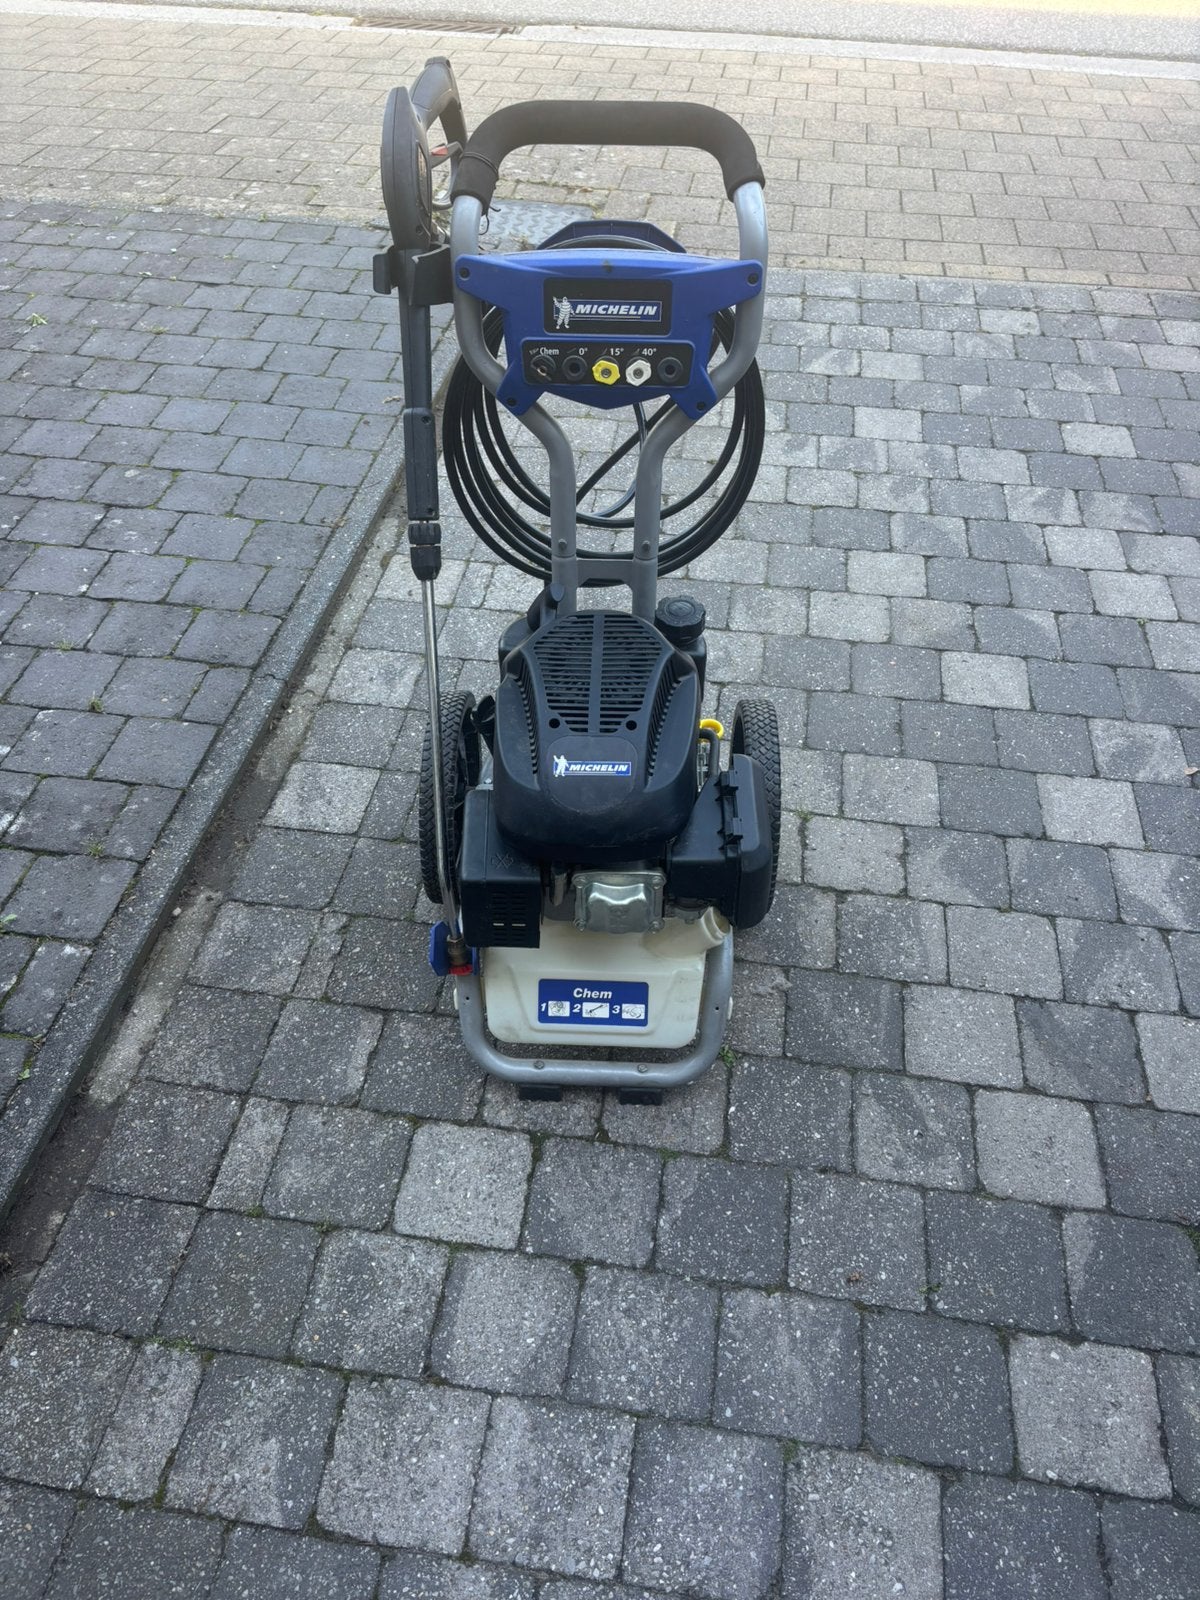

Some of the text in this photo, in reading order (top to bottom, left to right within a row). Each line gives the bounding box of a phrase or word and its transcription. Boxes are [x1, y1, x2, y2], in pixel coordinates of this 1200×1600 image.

[575, 304, 657, 315] MICHELIN
[539, 347, 560, 356] Chem
[610, 347, 624, 356] 15°
[641, 347, 657, 356] 40°
[569, 764, 628, 772] MICHELIN
[573, 987, 612, 999] Chem
[540, 1002, 621, 1014] 1 2 3
